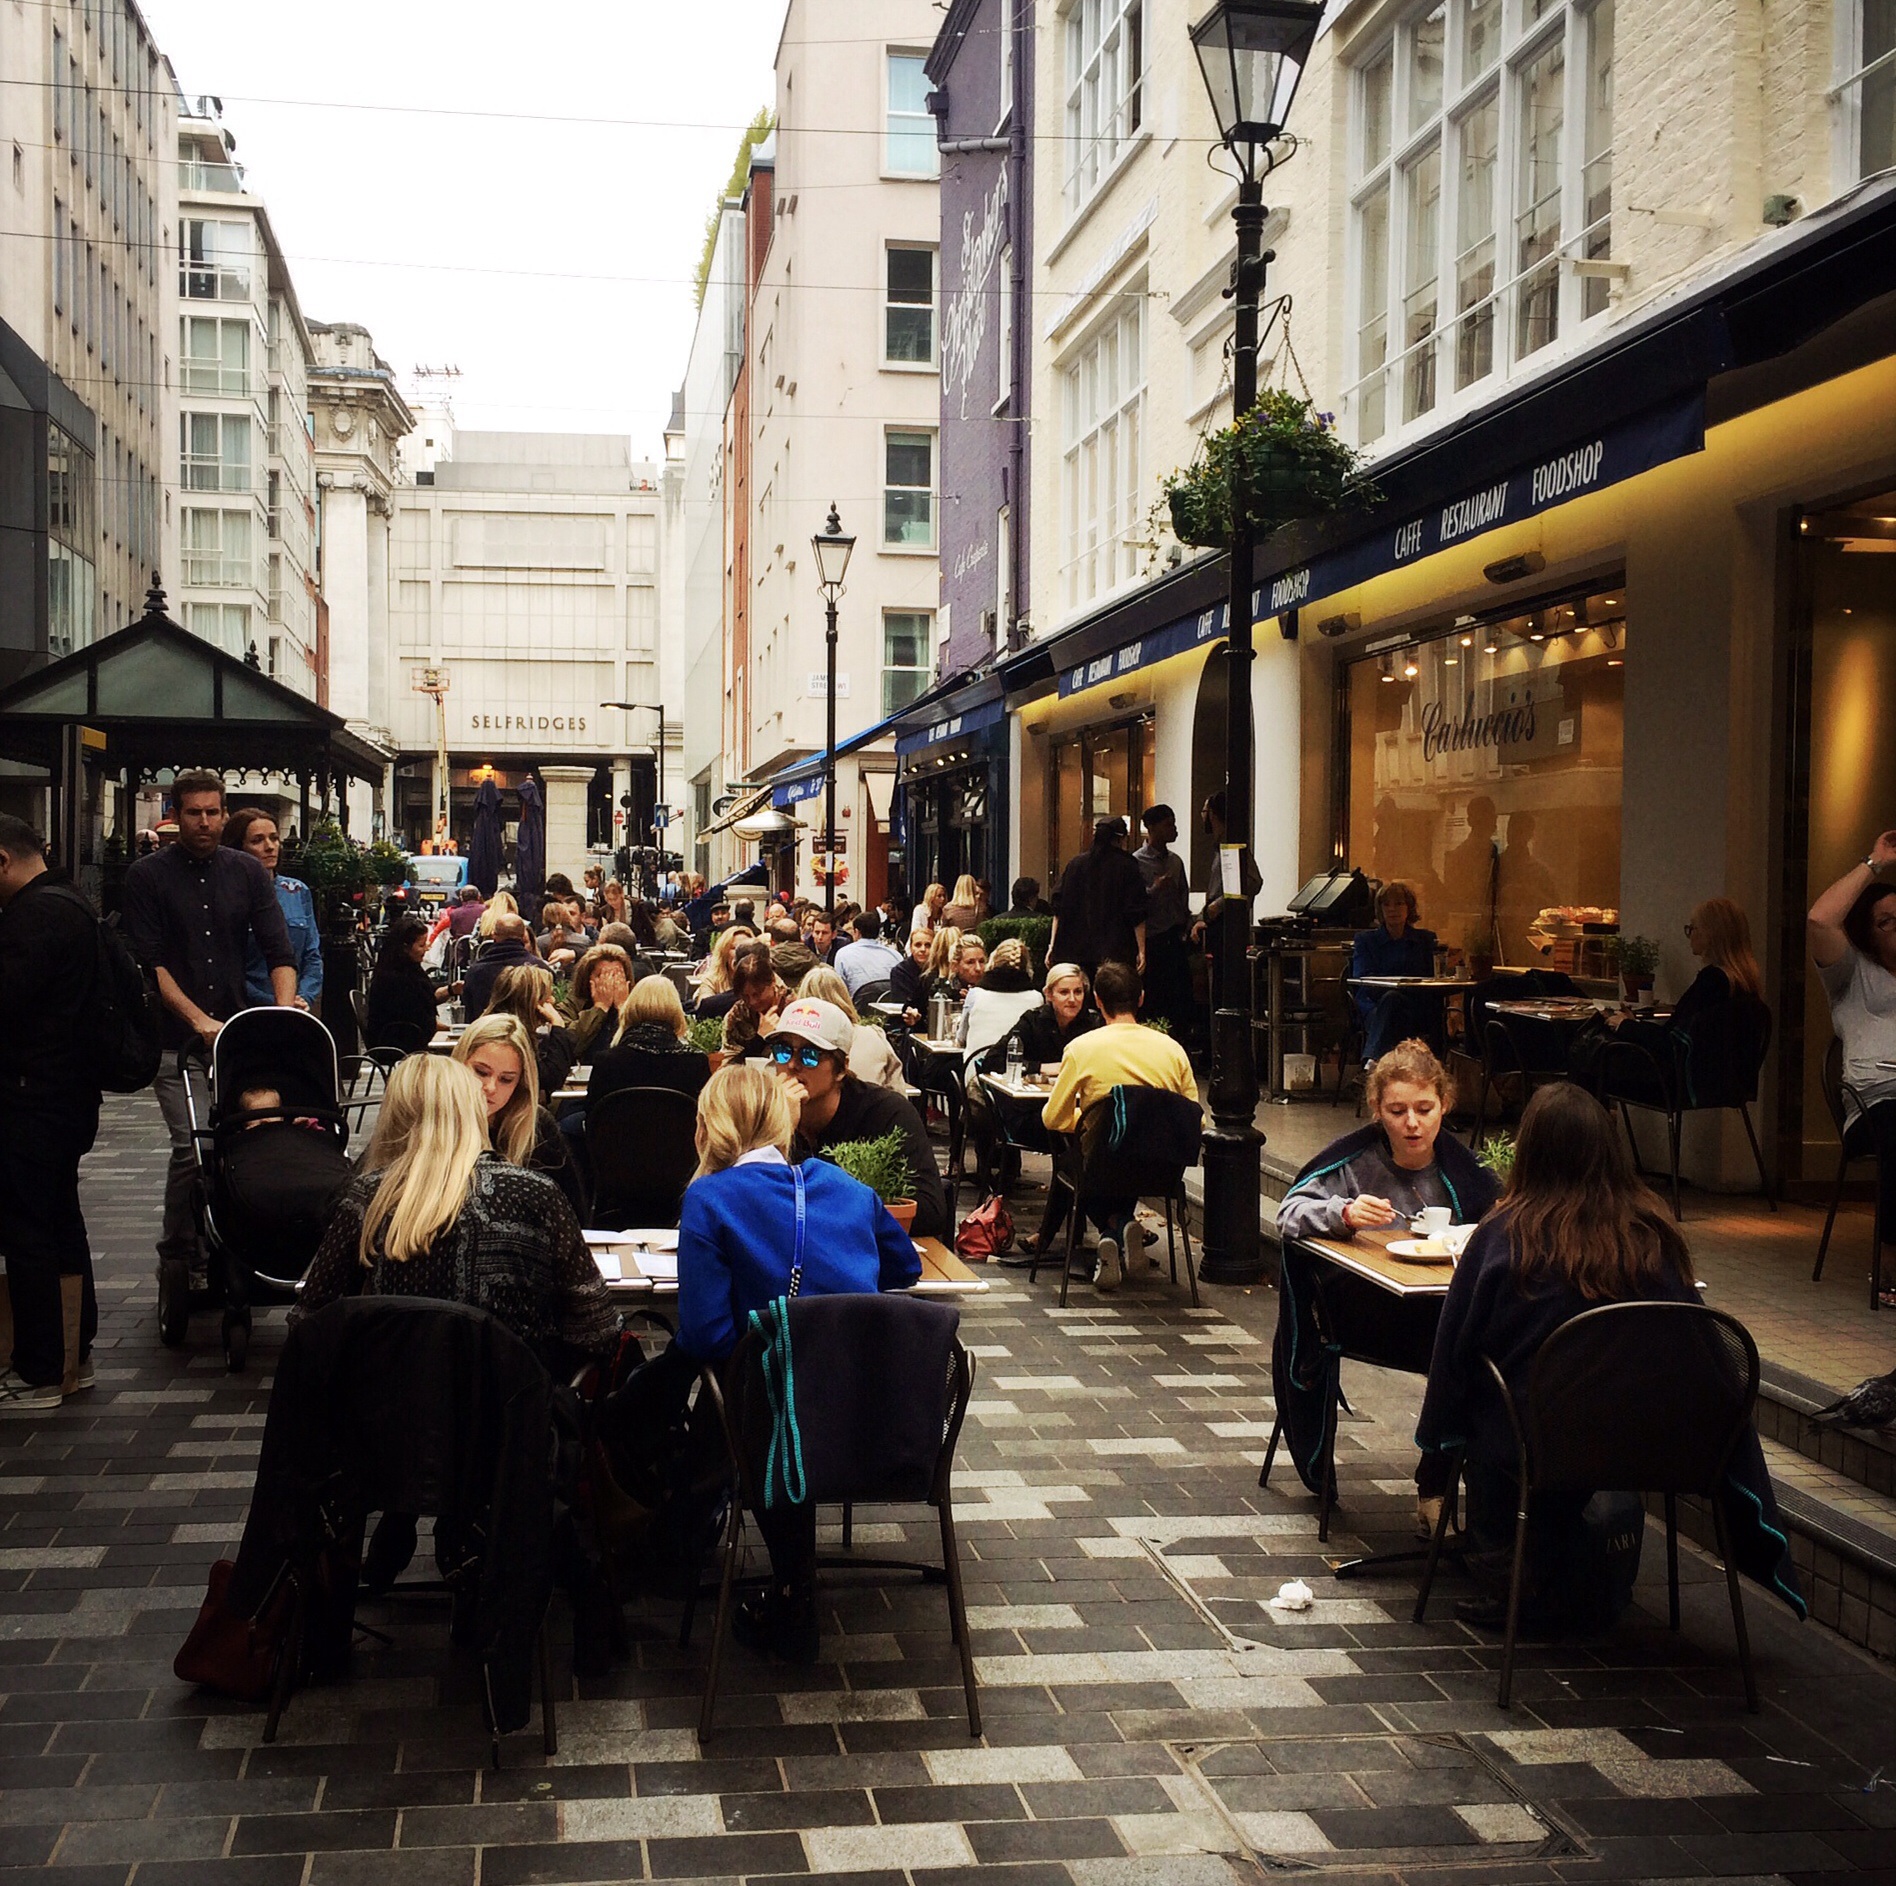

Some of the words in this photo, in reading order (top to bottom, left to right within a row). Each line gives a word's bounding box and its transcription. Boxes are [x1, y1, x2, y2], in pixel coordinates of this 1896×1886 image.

[1394, 519, 1423, 560] CAFFE
[1439, 481, 1509, 542] RESTAURANT
[1531, 440, 1603, 506] FOODSHOP
[1271, 569, 1310, 610] FOODSHOP
[472, 715, 586, 731] SELFRIDGES
[1421, 690, 1535, 763] Carluccio's
[786, 1018, 801, 1026] Red
[803, 1019, 821, 1030] Bull
